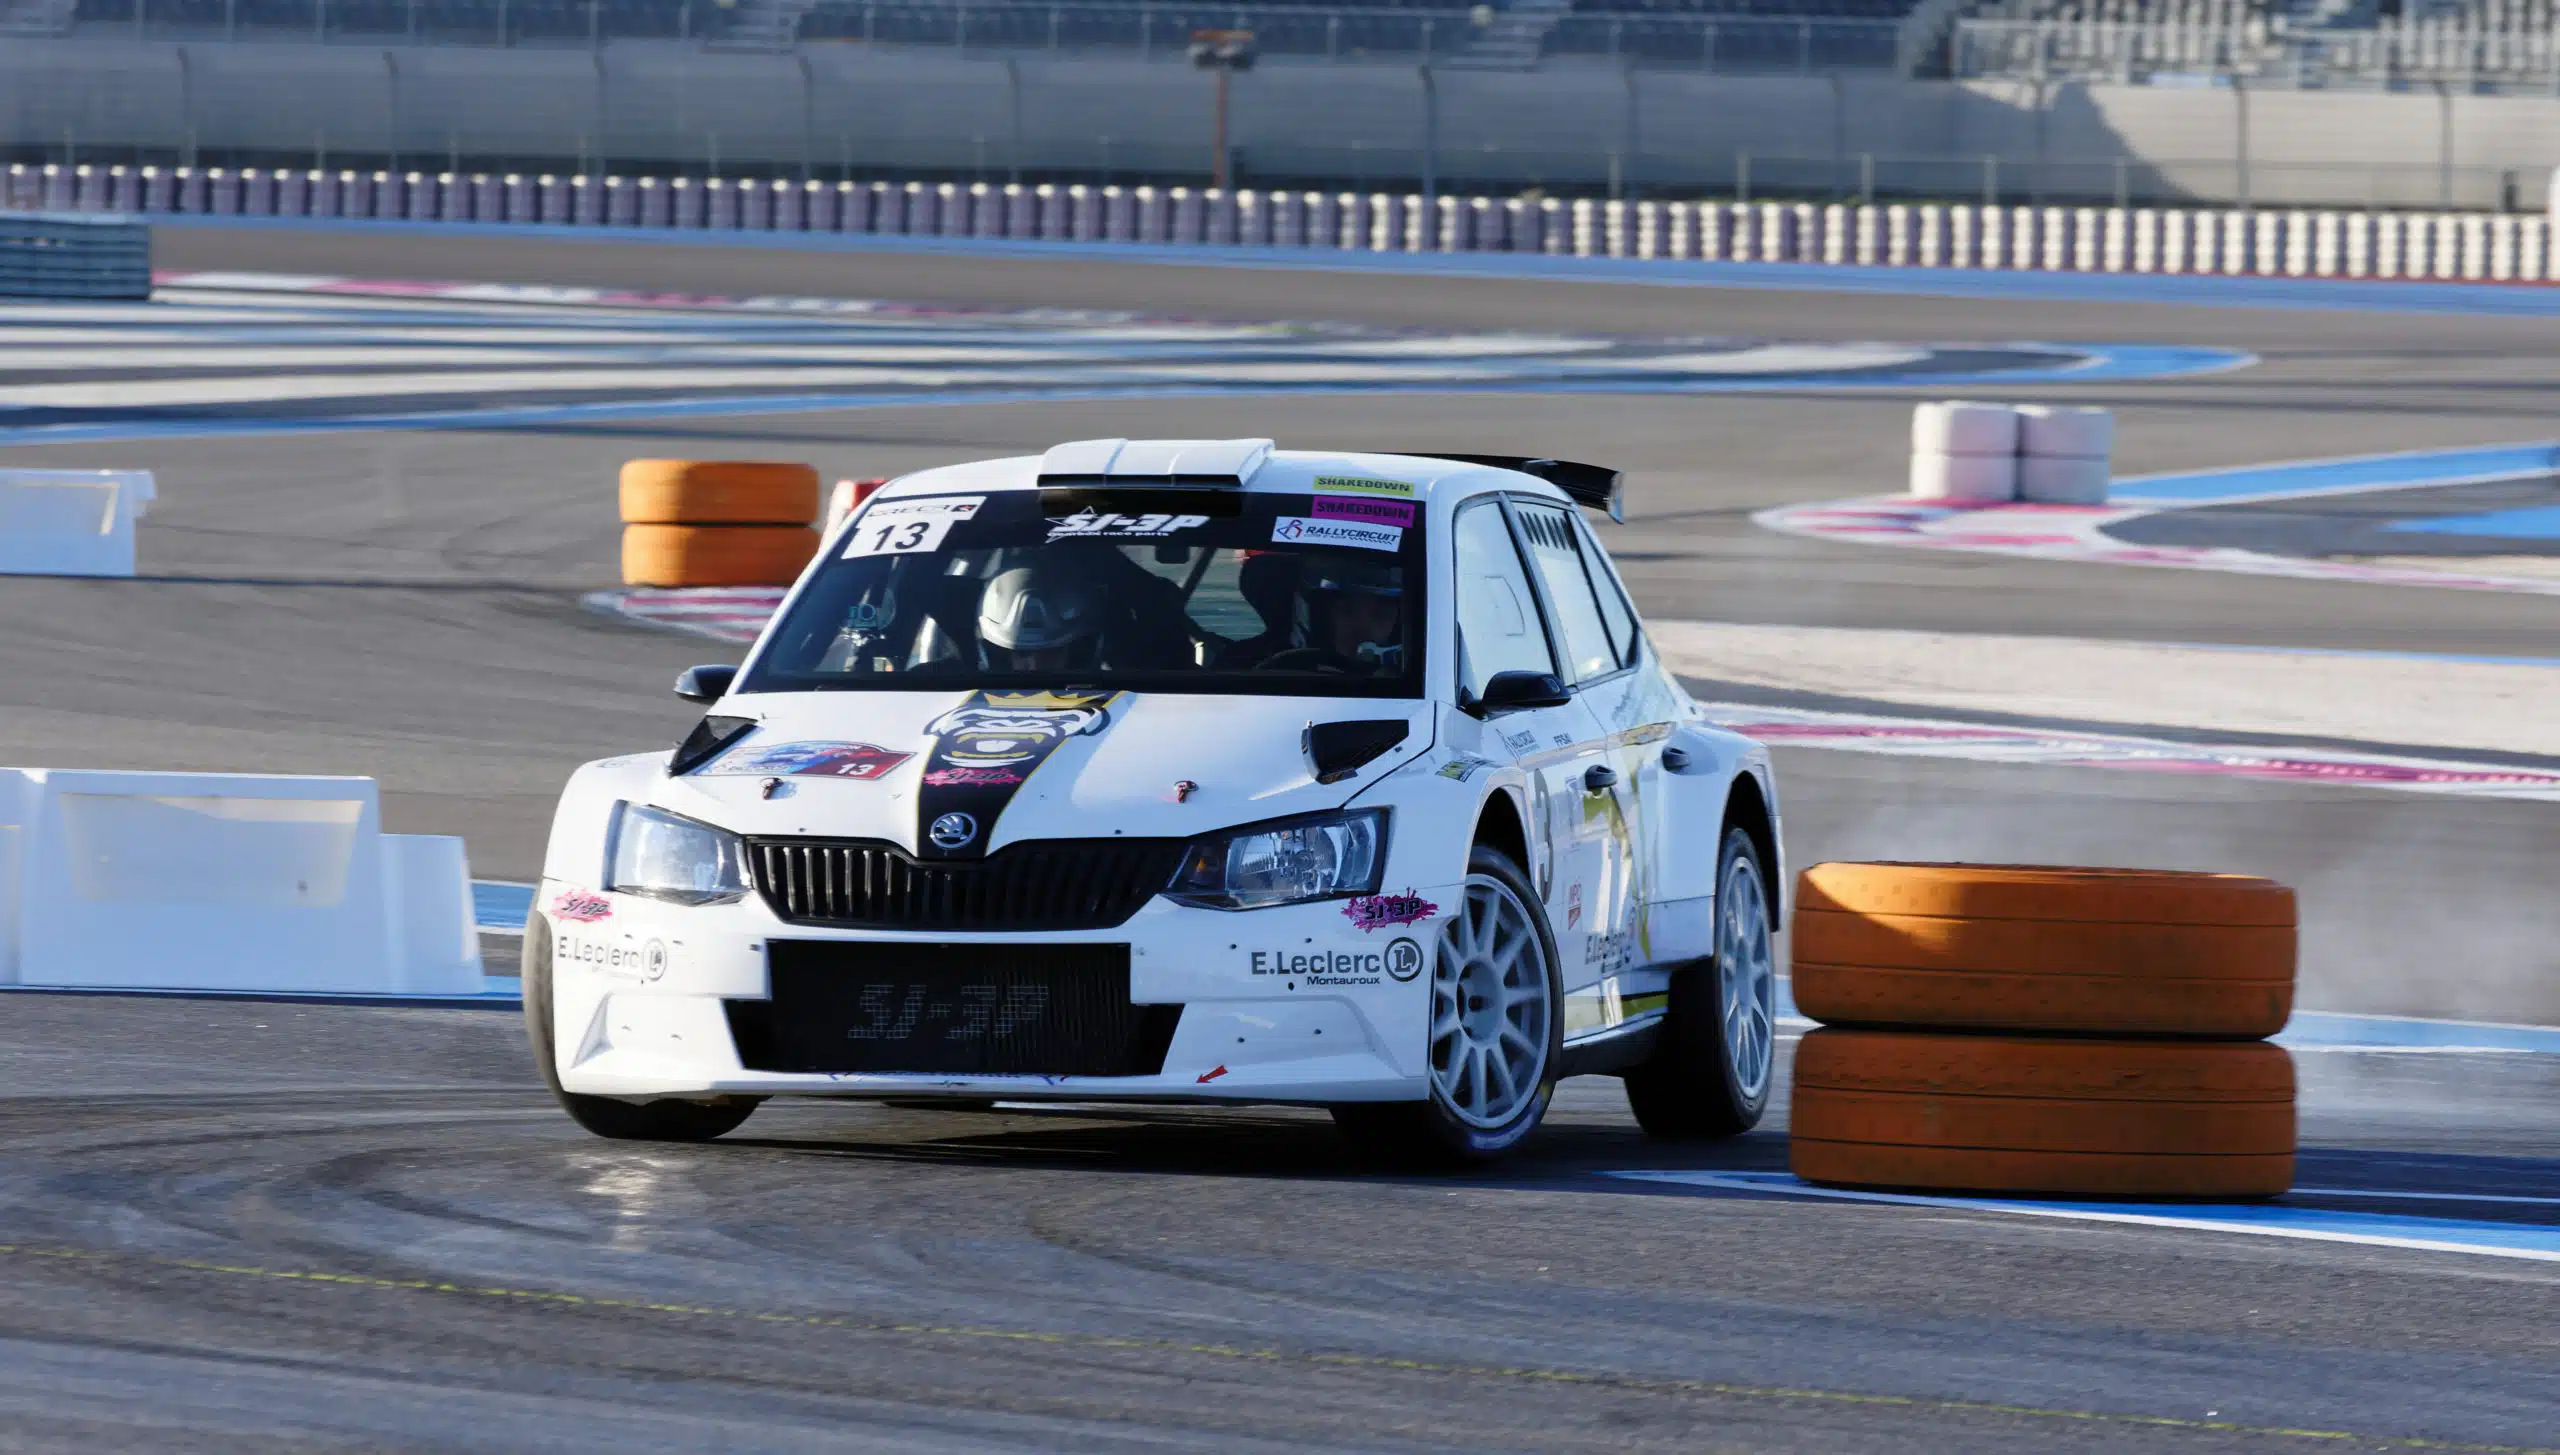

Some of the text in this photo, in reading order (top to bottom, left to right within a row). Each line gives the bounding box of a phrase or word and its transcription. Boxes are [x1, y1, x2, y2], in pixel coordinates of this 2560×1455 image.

[1318, 477, 1410, 492] SHAKEDOWN
[1317, 502, 1410, 519] SHAKEDOWN
[1050, 513, 1211, 532] SJ-3P
[873, 522, 930, 551] 13
[1306, 526, 1400, 543] RALLYCIRCUIT
[836, 763, 876, 776] 13
[559, 936, 640, 968] E.Leclerc
[1251, 951, 1380, 975] E.Leclerc
[1307, 976, 1380, 985] Montauroux
